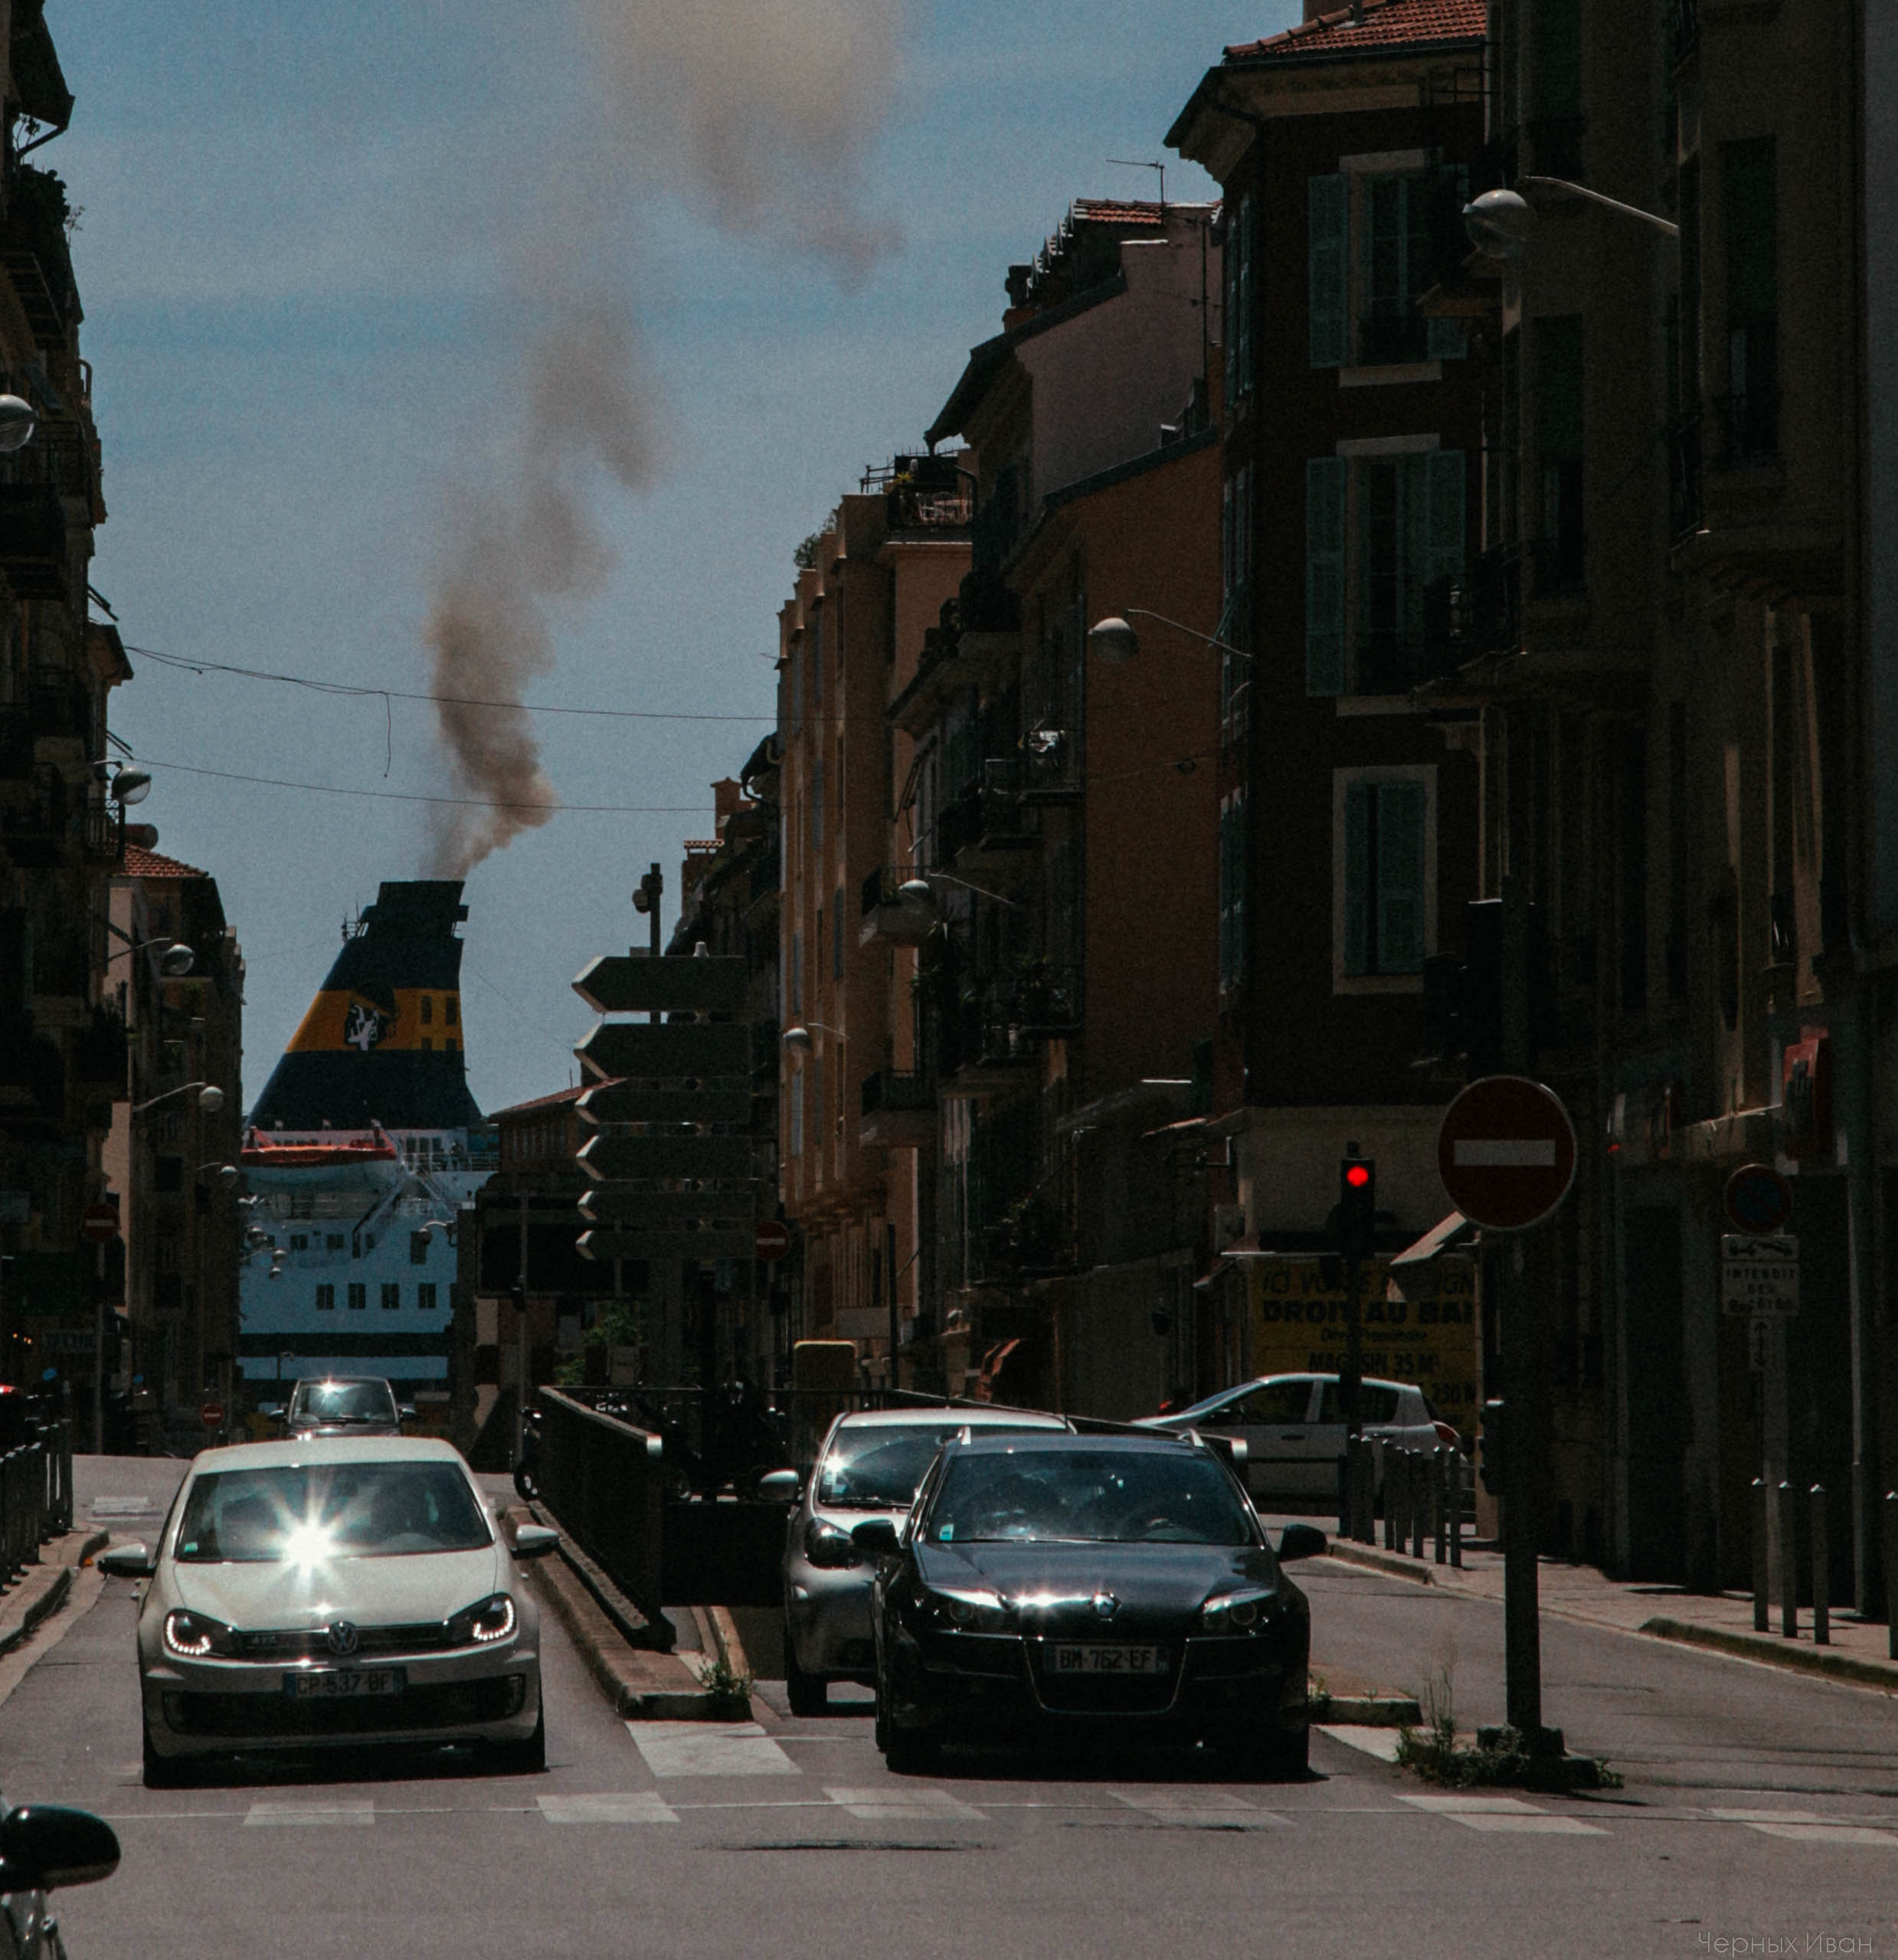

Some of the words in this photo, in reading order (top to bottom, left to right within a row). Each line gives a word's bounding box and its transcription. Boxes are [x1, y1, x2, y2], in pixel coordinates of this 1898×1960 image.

[1726, 1268, 1795, 1280] INTERDIT
[1419, 1301, 1475, 1324] BAI
[1308, 1352, 1387, 1374] MAGSIN
